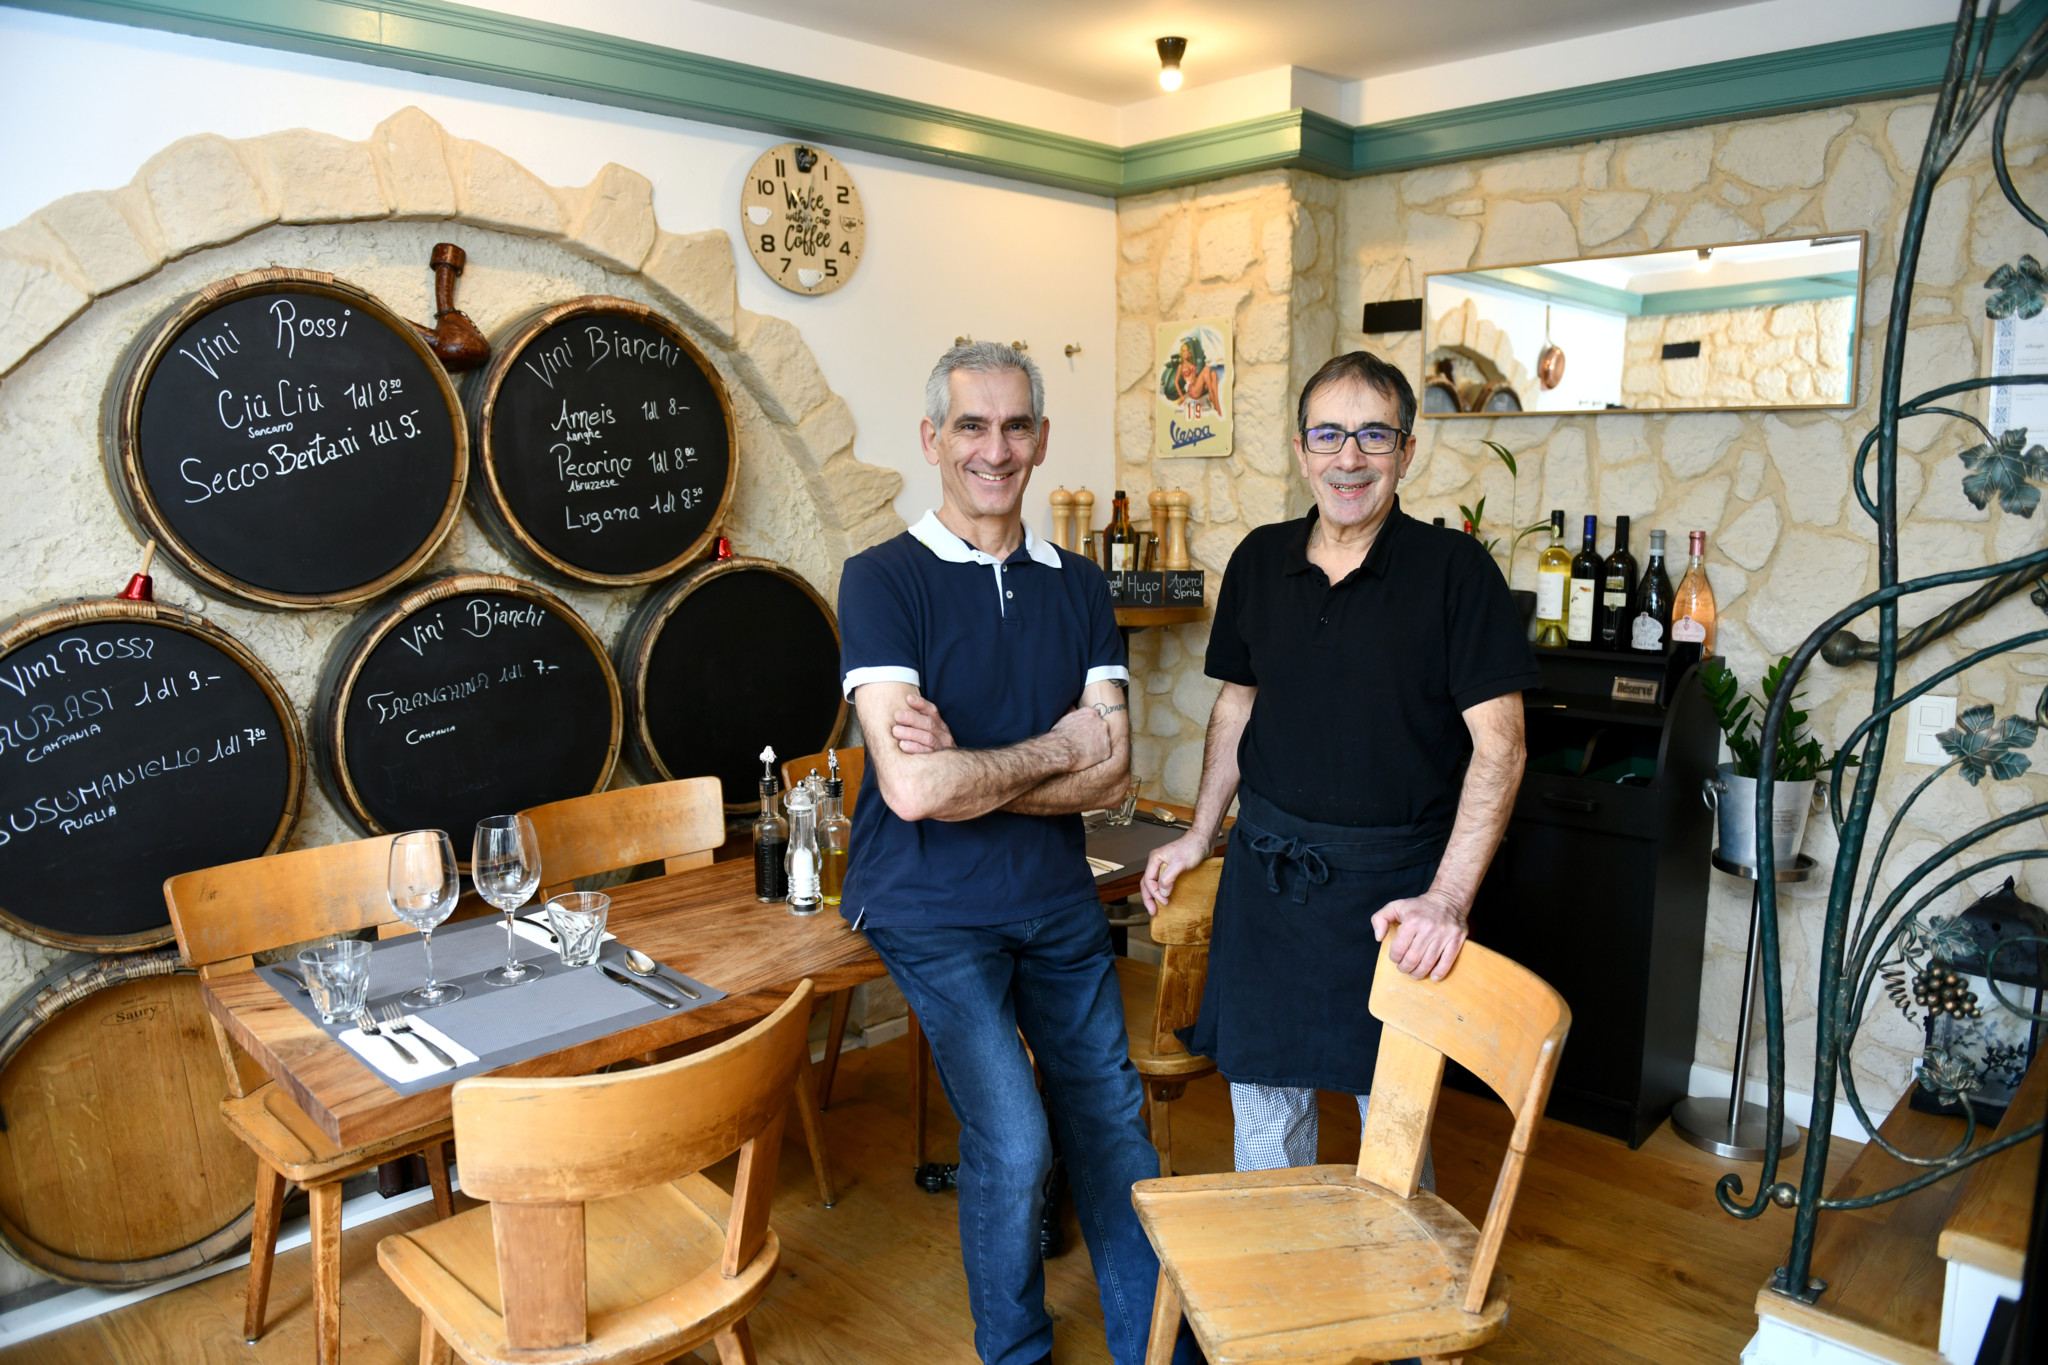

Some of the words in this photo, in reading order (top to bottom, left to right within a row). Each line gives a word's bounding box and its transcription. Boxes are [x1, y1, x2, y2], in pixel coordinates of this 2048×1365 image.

[775, 158, 785, 178] 11
[757, 179, 775, 196] 10
[783, 181, 825, 211] Wake
[836, 185, 850, 204] 2
[815, 215, 830, 230] cup
[760, 234, 776, 253] 8
[784, 224, 831, 257] Coffee
[838, 241, 851, 256] 4
[780, 257, 792, 273] 7
[824, 258, 838, 277] 5
[180, 322, 240, 379] Vini
[269, 299, 351, 358] Rossi
[525, 337, 573, 389] Vini
[584, 326, 681, 373] Bianchi
[1170, 419, 1216, 450] Vespa
[180, 457, 269, 503] Secco
[267, 427, 361, 475] Bertani
[549, 443, 633, 481] Pecorino
[567, 479, 620, 493] Abruzzese
[566, 506, 640, 534] Lugana
[1127, 574, 1161, 604] Hugo
[1167, 573, 1204, 592] Aperol
[400, 613, 445, 656] Vini
[461, 599, 546, 638] Bianchi
[59, 804, 118, 835] PUGLIA
[116, 1005, 158, 1023] Saury
